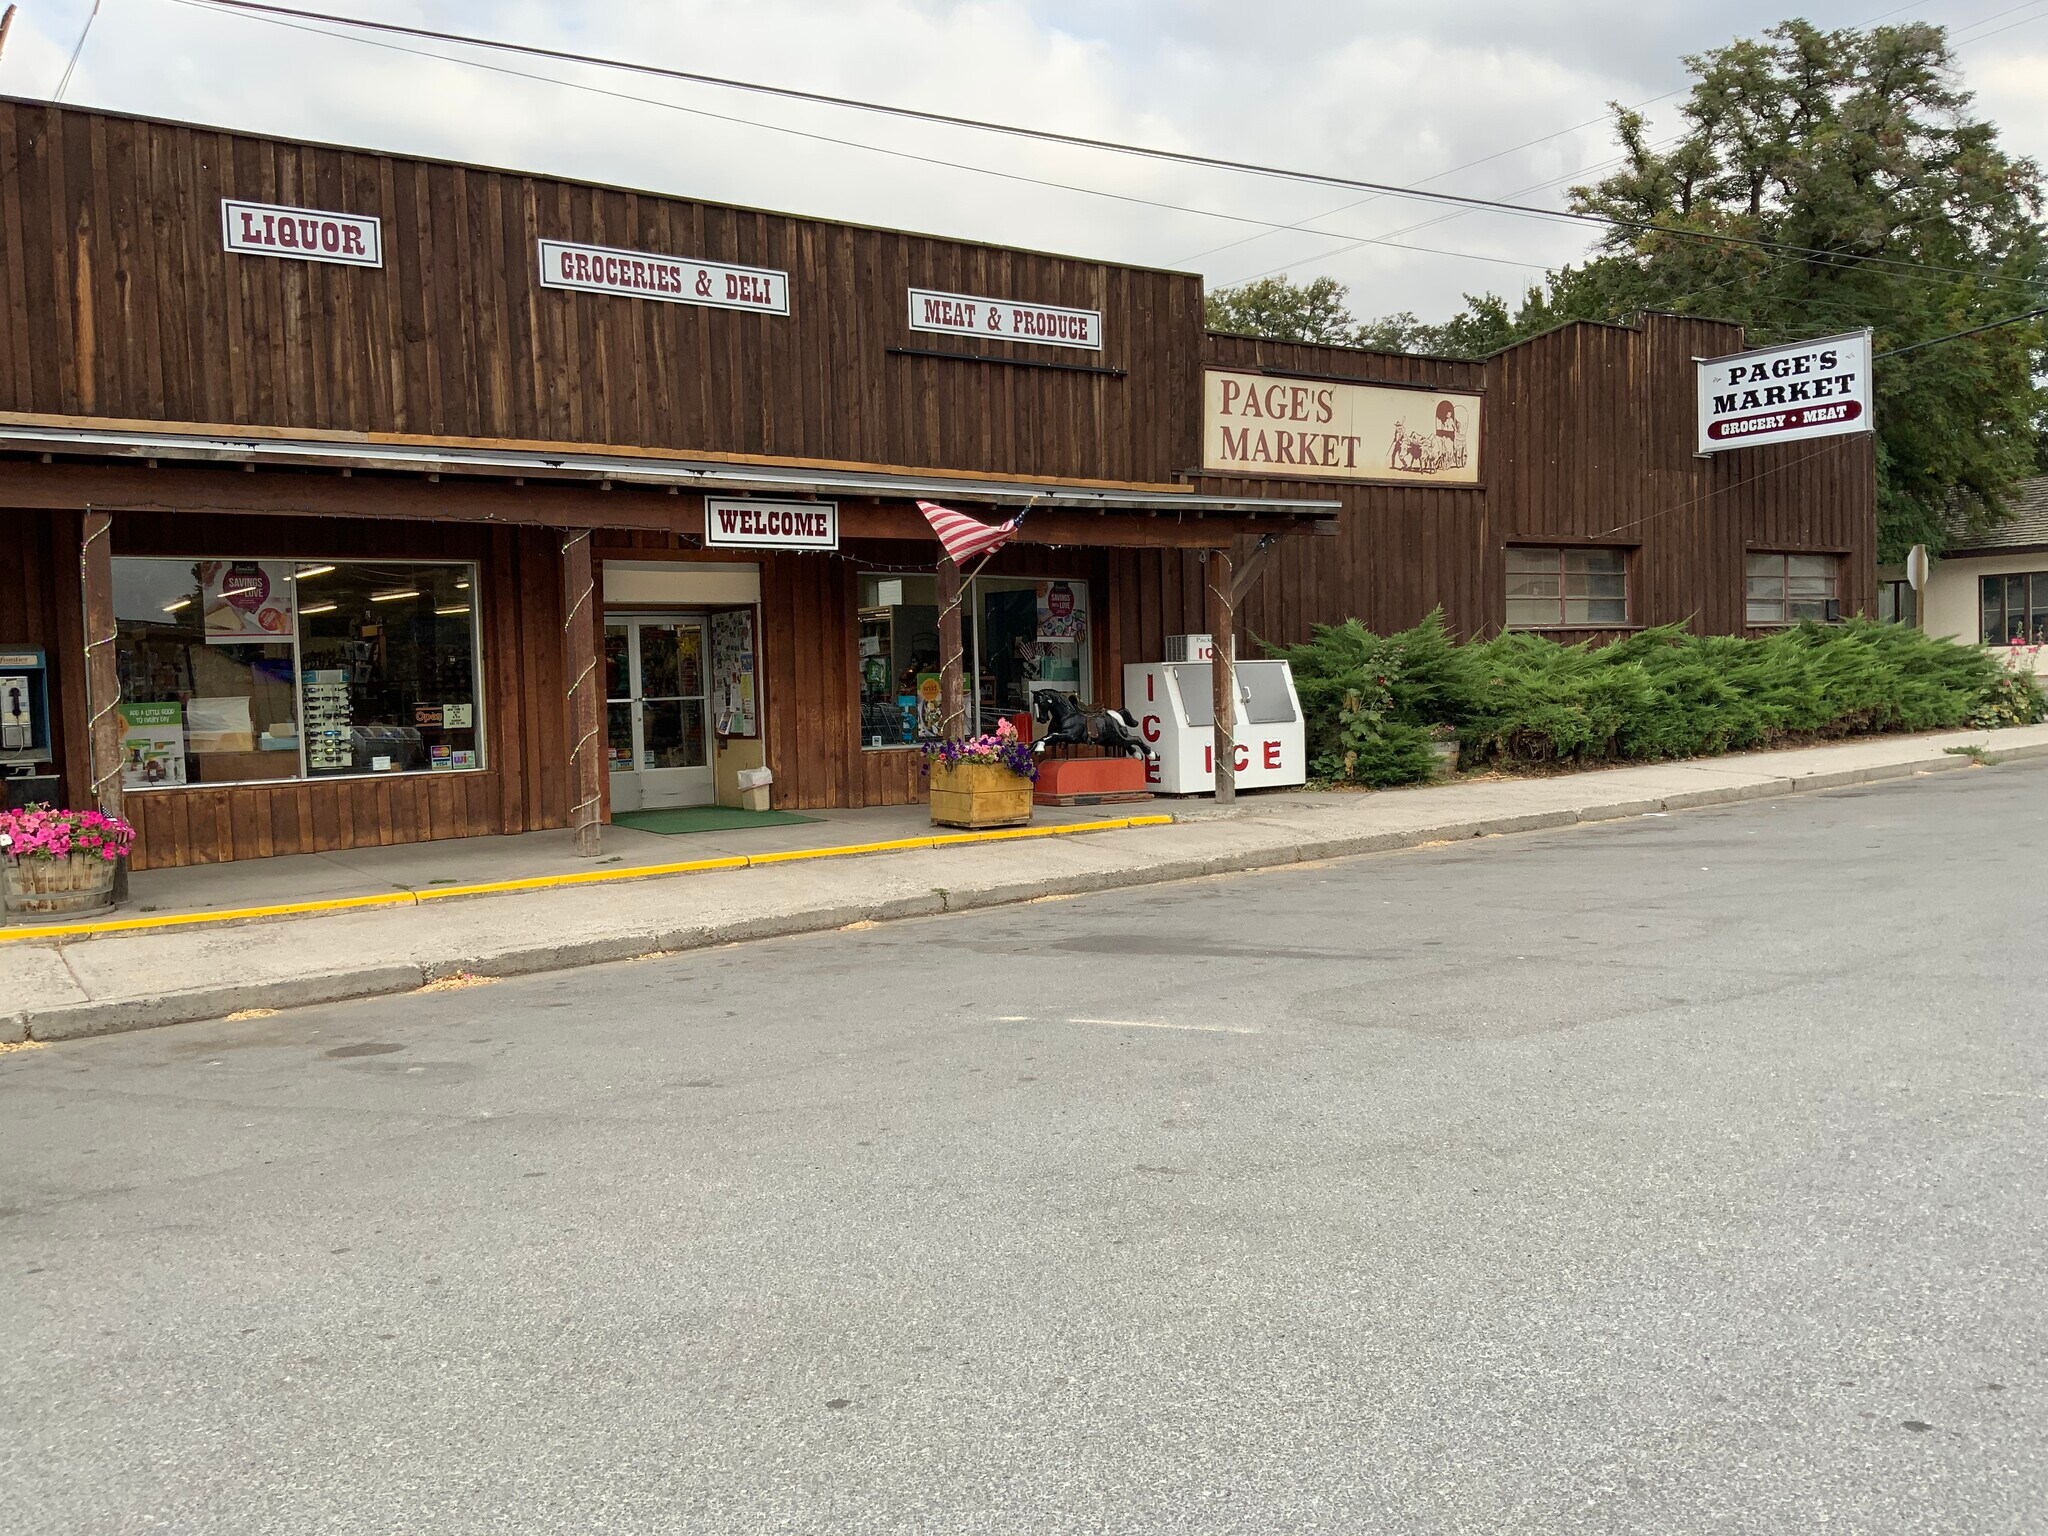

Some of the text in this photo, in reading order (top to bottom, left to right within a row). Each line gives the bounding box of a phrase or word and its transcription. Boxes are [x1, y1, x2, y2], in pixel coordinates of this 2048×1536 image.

[241, 212, 366, 255] LIQUOR
[561, 251, 772, 305] GROCERIES & DELI
[924, 298, 1088, 341] MEAT & PRODUCE
[1728, 350, 1838, 387] PAGE'S
[1219, 379, 1334, 424] PAGE'S
[1712, 373, 1856, 415] MARKET
[1720, 405, 1848, 436] GROCERY MEAT
[1219, 425, 1361, 469] MARKET
[717, 509, 828, 537] WELCOME
[228, 577, 263, 588] SAVINGS
[244, 588, 264, 598] LOVE
[1051, 593, 1071, 602] SAVINGS
[1142, 673, 1162, 784] ICE
[1204, 739, 1282, 774] ICE
